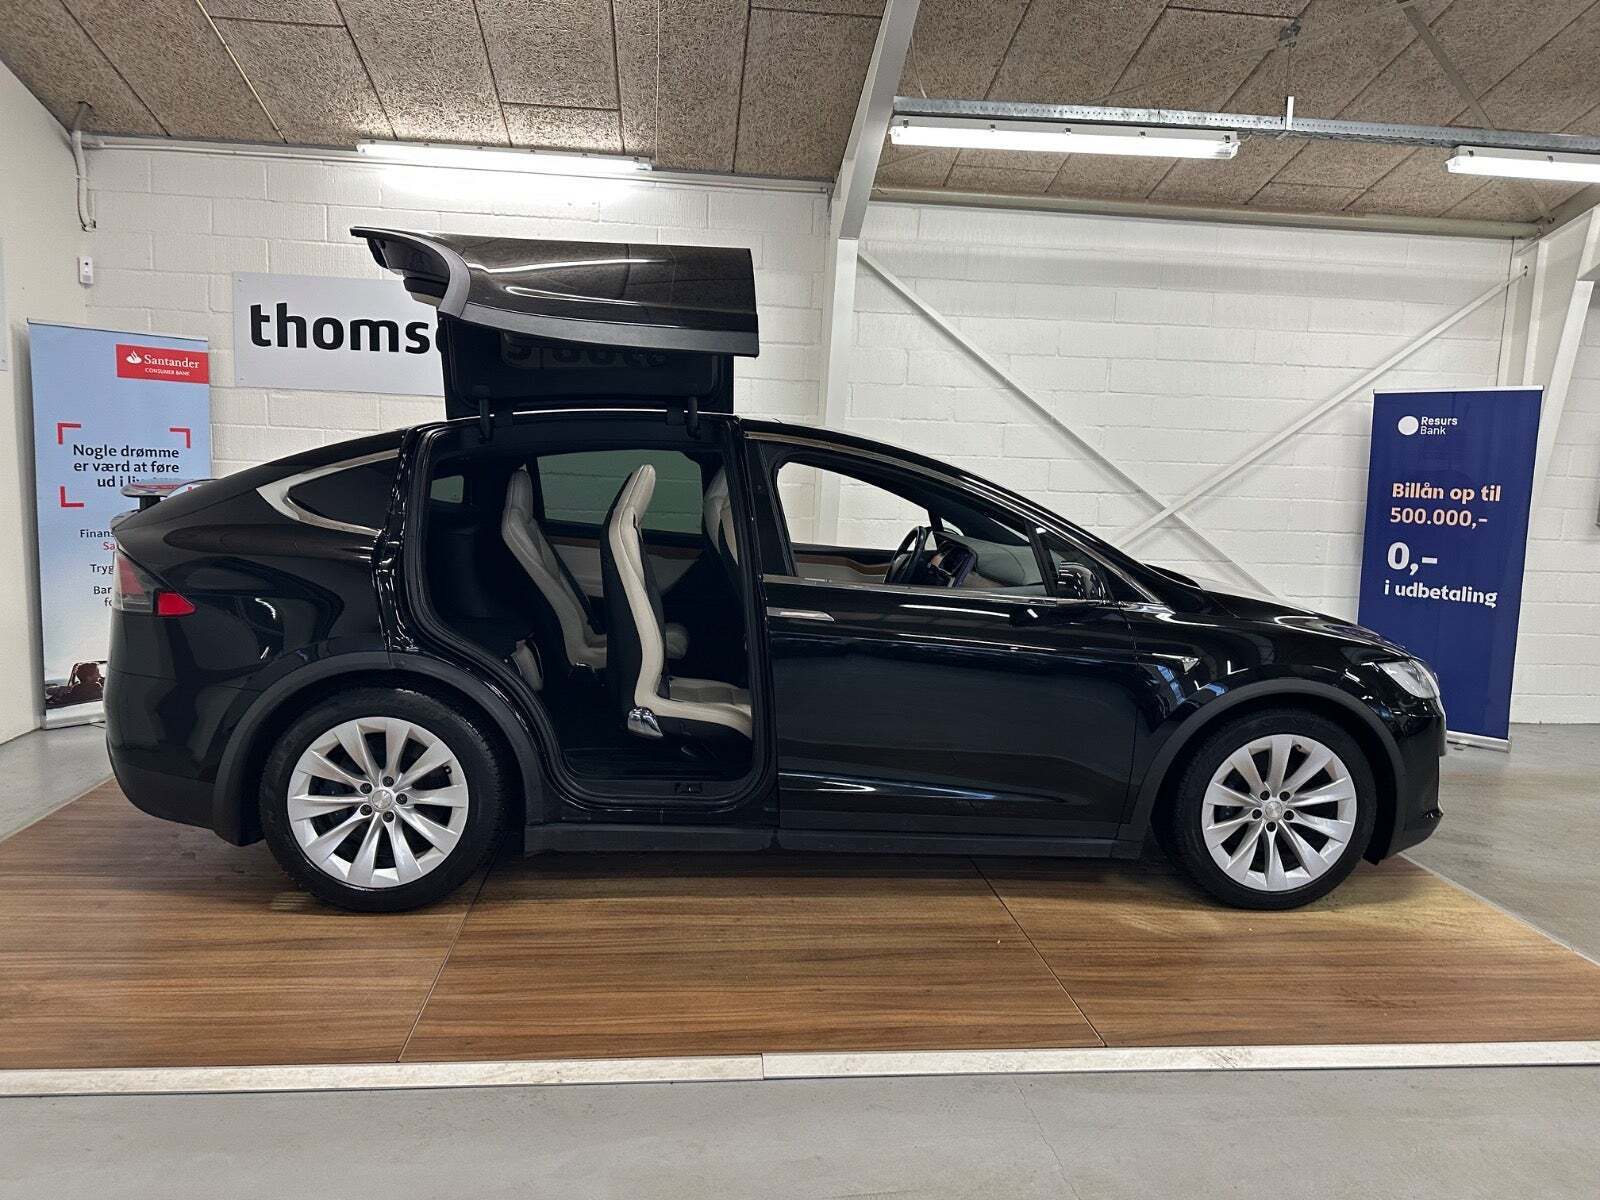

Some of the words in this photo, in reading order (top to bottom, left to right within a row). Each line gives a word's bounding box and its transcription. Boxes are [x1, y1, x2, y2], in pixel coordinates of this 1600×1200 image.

[250, 302, 441, 354] thoms
[144, 354, 199, 368] Santander
[1421, 416, 1458, 425] Resurs
[1420, 426, 1446, 435] Bank
[73, 444, 117, 459] Nogle
[121, 445, 179, 458] drømme
[73, 462, 88, 472] er
[93, 461, 130, 472] værd
[133, 462, 148, 472] at
[151, 461, 179, 473] føre
[97, 476, 116, 487] ud
[119, 475, 124, 487] i
[1392, 482, 1444, 499] Billån
[1449, 488, 1475, 504] op
[1481, 485, 1501, 502] til
[1384, 580, 1390, 595] i
[1395, 582, 1498, 608] udbetaling
